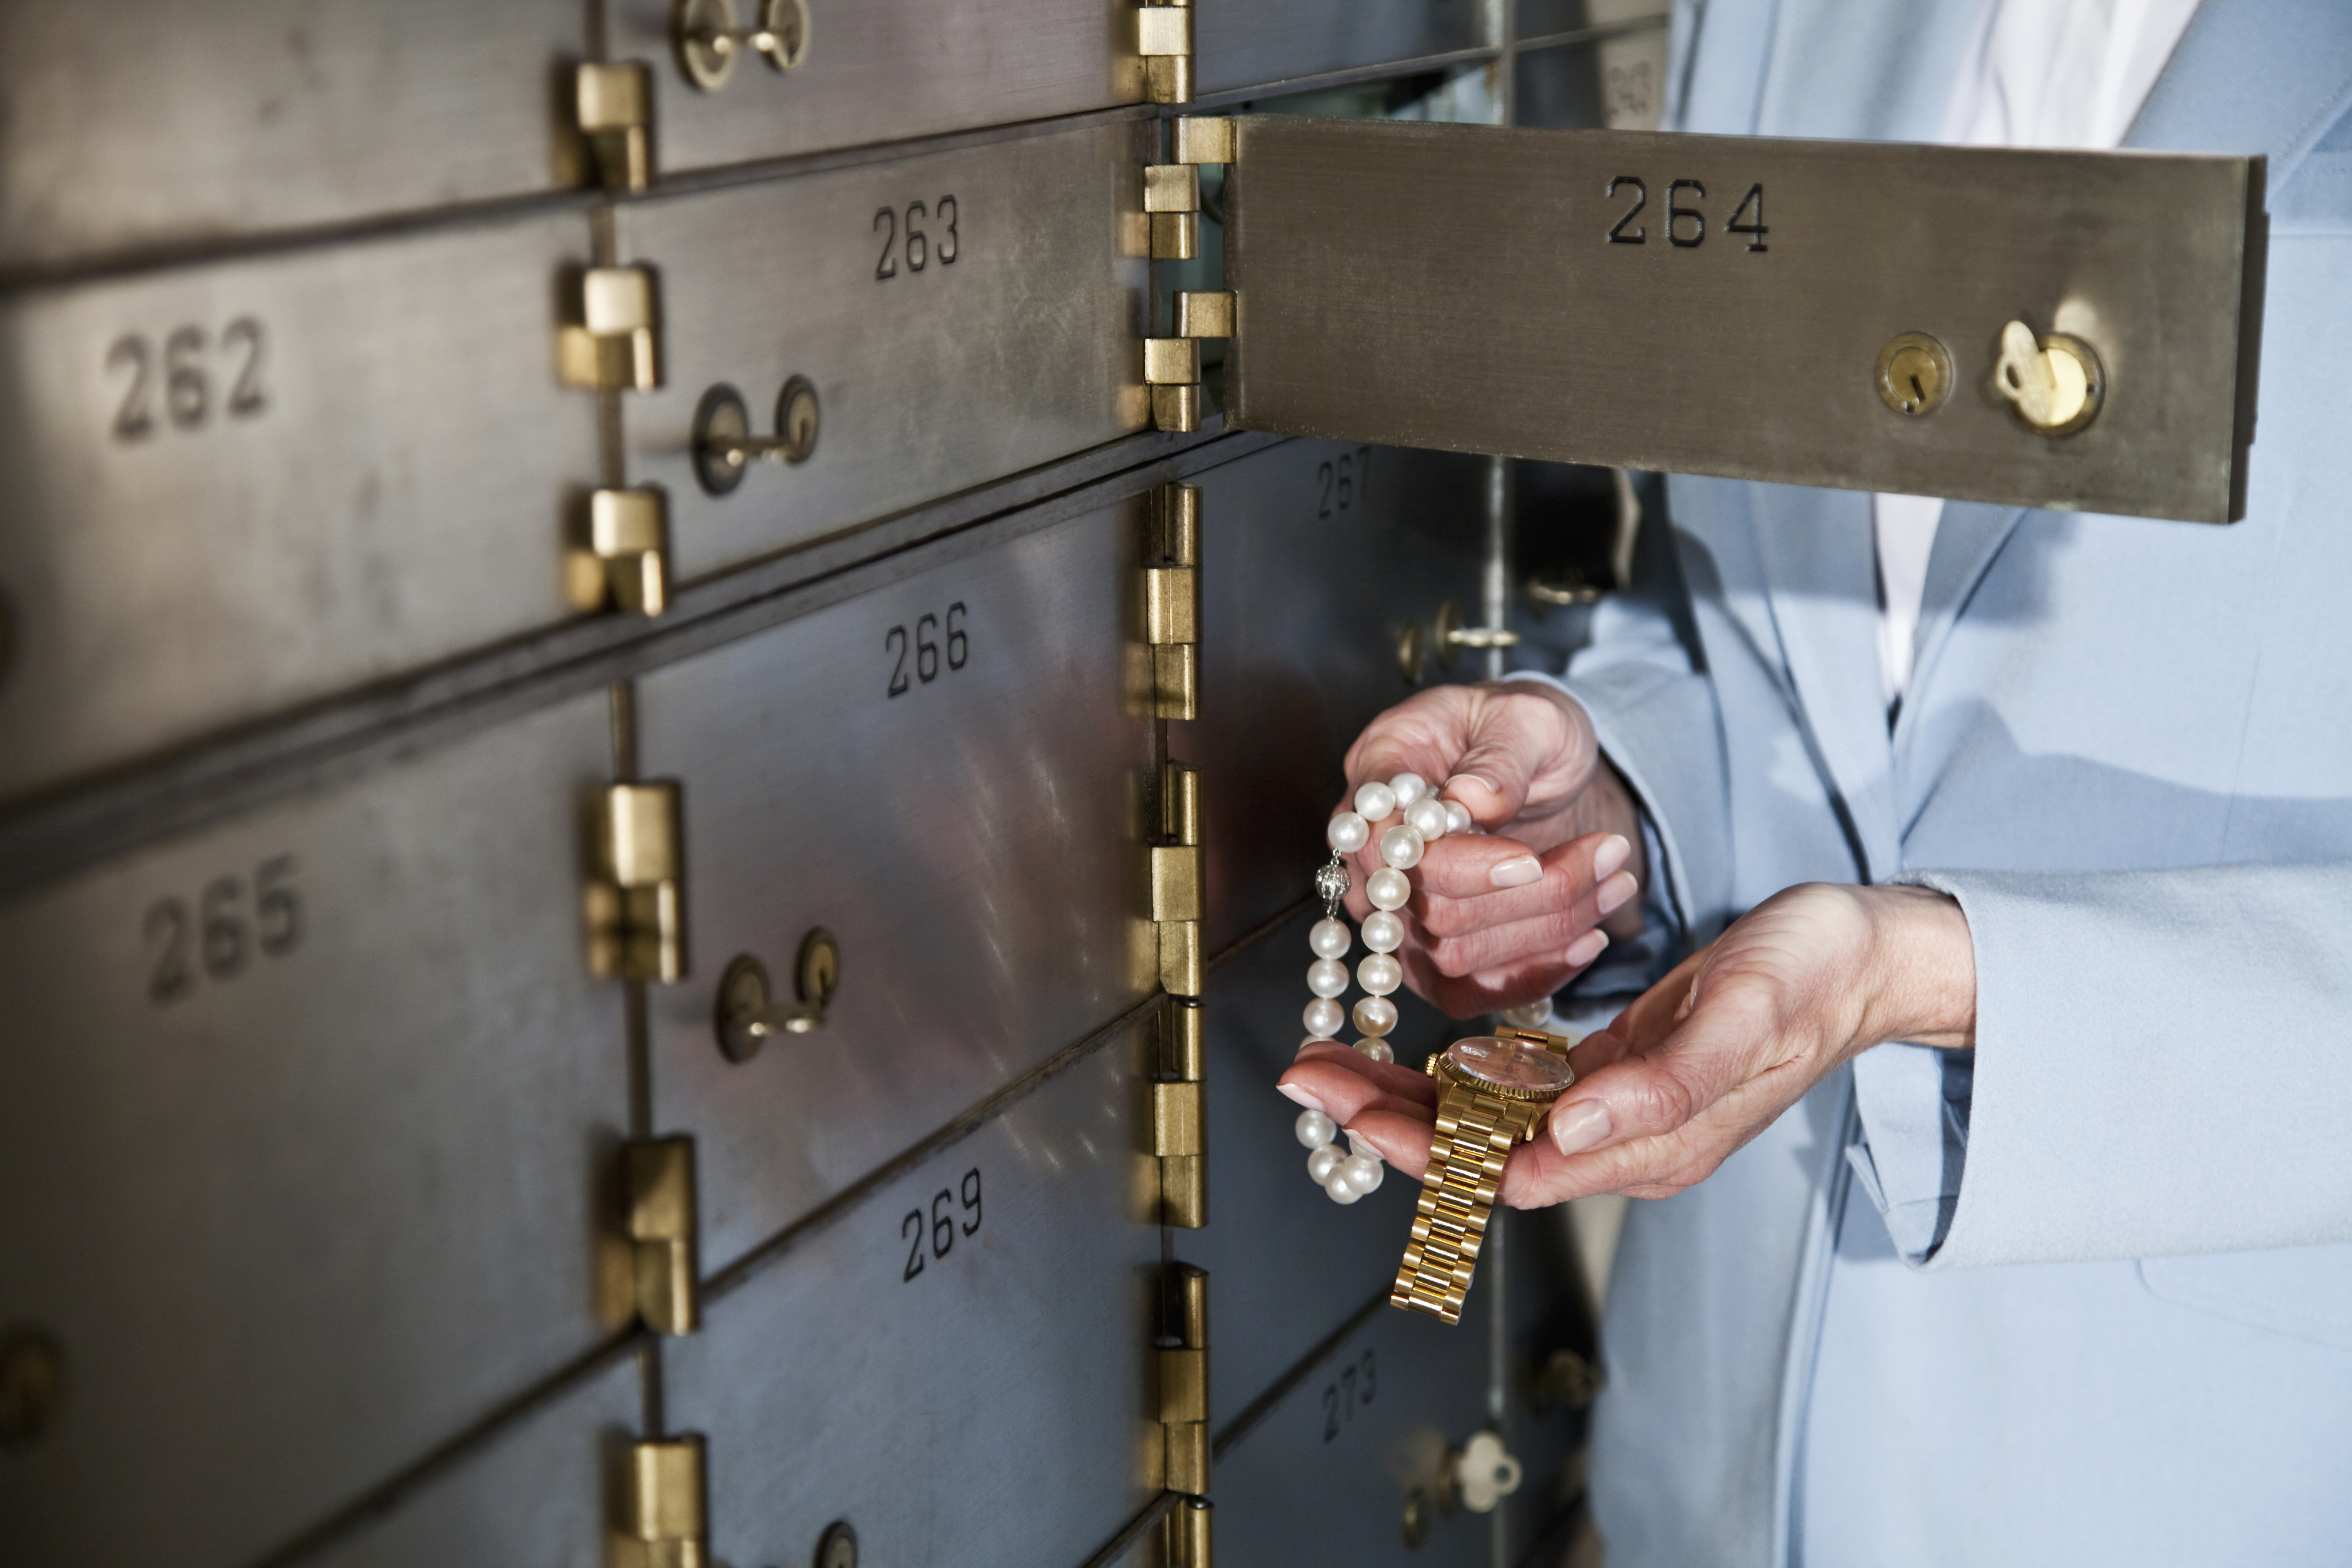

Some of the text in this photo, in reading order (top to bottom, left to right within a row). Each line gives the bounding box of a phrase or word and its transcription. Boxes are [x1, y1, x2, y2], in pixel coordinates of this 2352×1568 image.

[873, 193, 957, 280] 263
[1607, 176, 1769, 252] 264
[103, 313, 266, 447] 262
[1318, 444, 1372, 519] 267
[885, 600, 968, 698] 266
[143, 852, 303, 1002] 265
[901, 1167, 981, 1283] 269
[1322, 1348, 1377, 1444] 273
